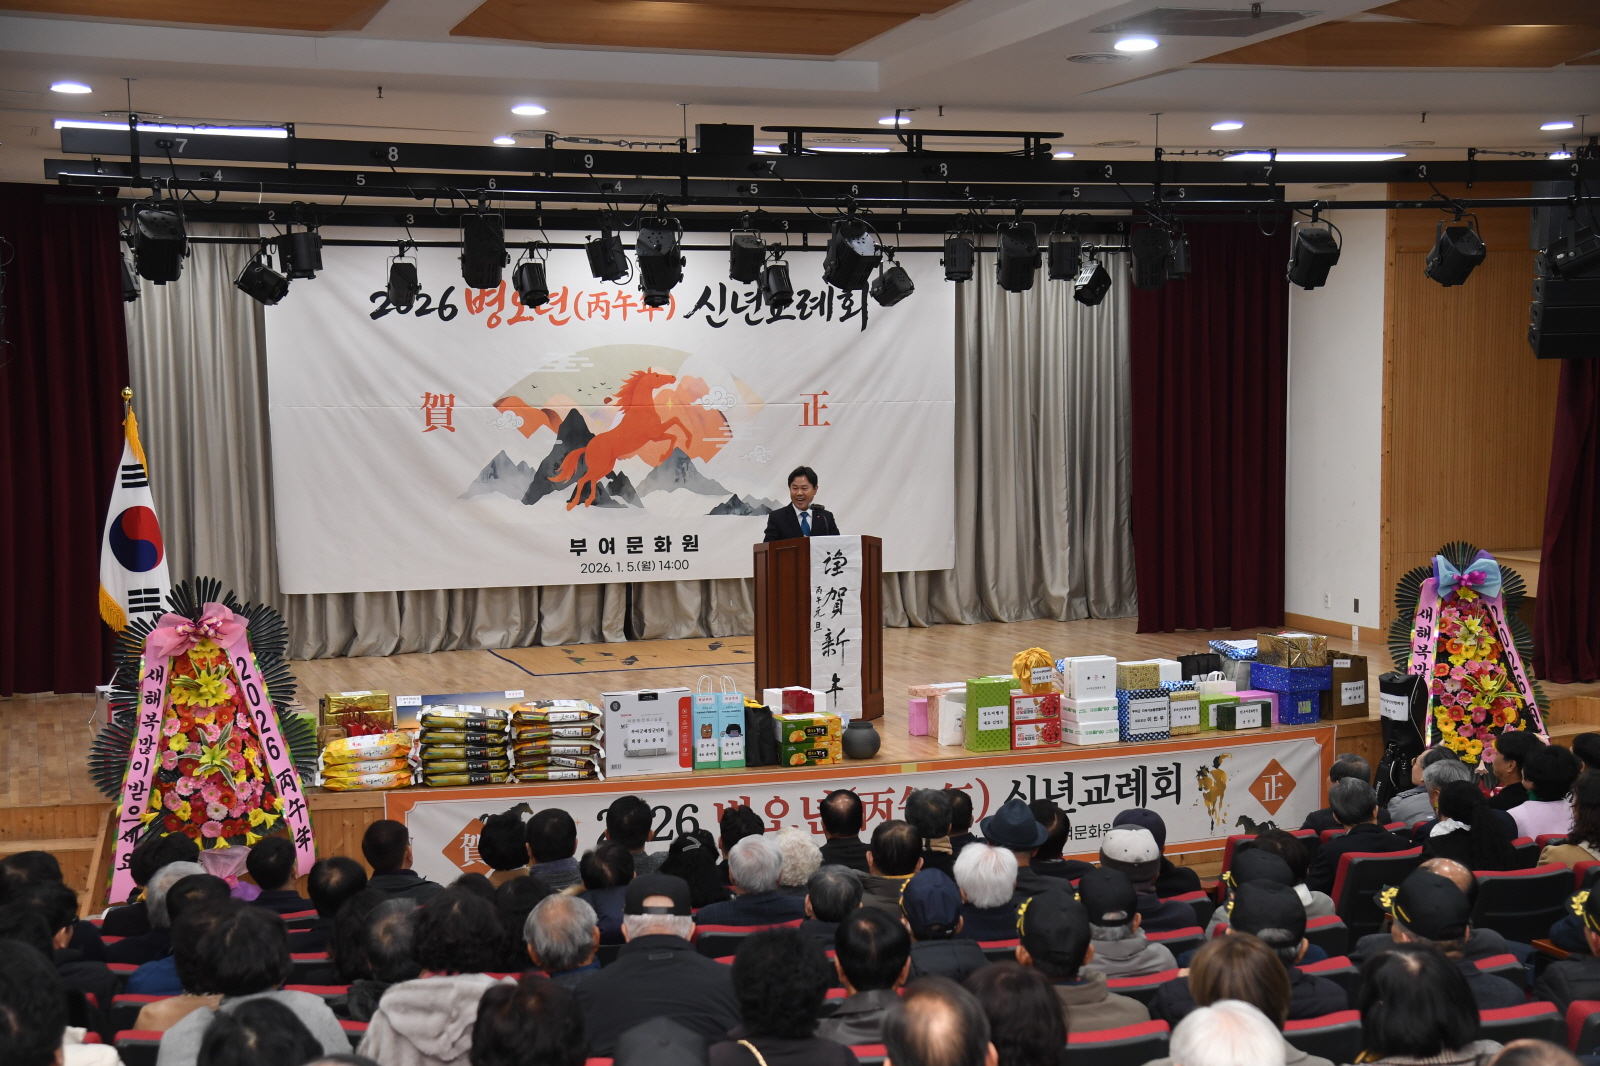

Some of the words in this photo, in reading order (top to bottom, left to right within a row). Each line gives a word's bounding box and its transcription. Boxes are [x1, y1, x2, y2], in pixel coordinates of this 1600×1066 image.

[175, 139, 188, 153] 7
[388, 147, 399, 161] 8
[584, 154, 594, 168] 9
[766, 161, 776, 174] 7
[1263, 166, 1273, 178] 7
[214, 170, 223, 181] 4
[356, 174, 366, 185] 5
[488, 178, 497, 189] 6
[614, 181, 622, 191] 4
[750, 183, 758, 194] 5
[851, 184, 858, 195] 6
[1072, 187, 1080, 197] 5
[121, 206, 128, 217] 1
[268, 210, 275, 221] 2
[406, 214, 414, 224] 3
[537, 217, 542, 227] 1
[781, 220, 789, 230] 3
[897, 221, 901, 231] 1
[420, 392, 456, 433] 賀
[799, 390, 831, 427] 正
[580, 562, 613, 573] 2026.
[616, 562, 624, 572] 1.
[658, 559, 689, 570] 14:00
[235, 656, 281, 761] 2026
[1262, 771, 1283, 801] 正
